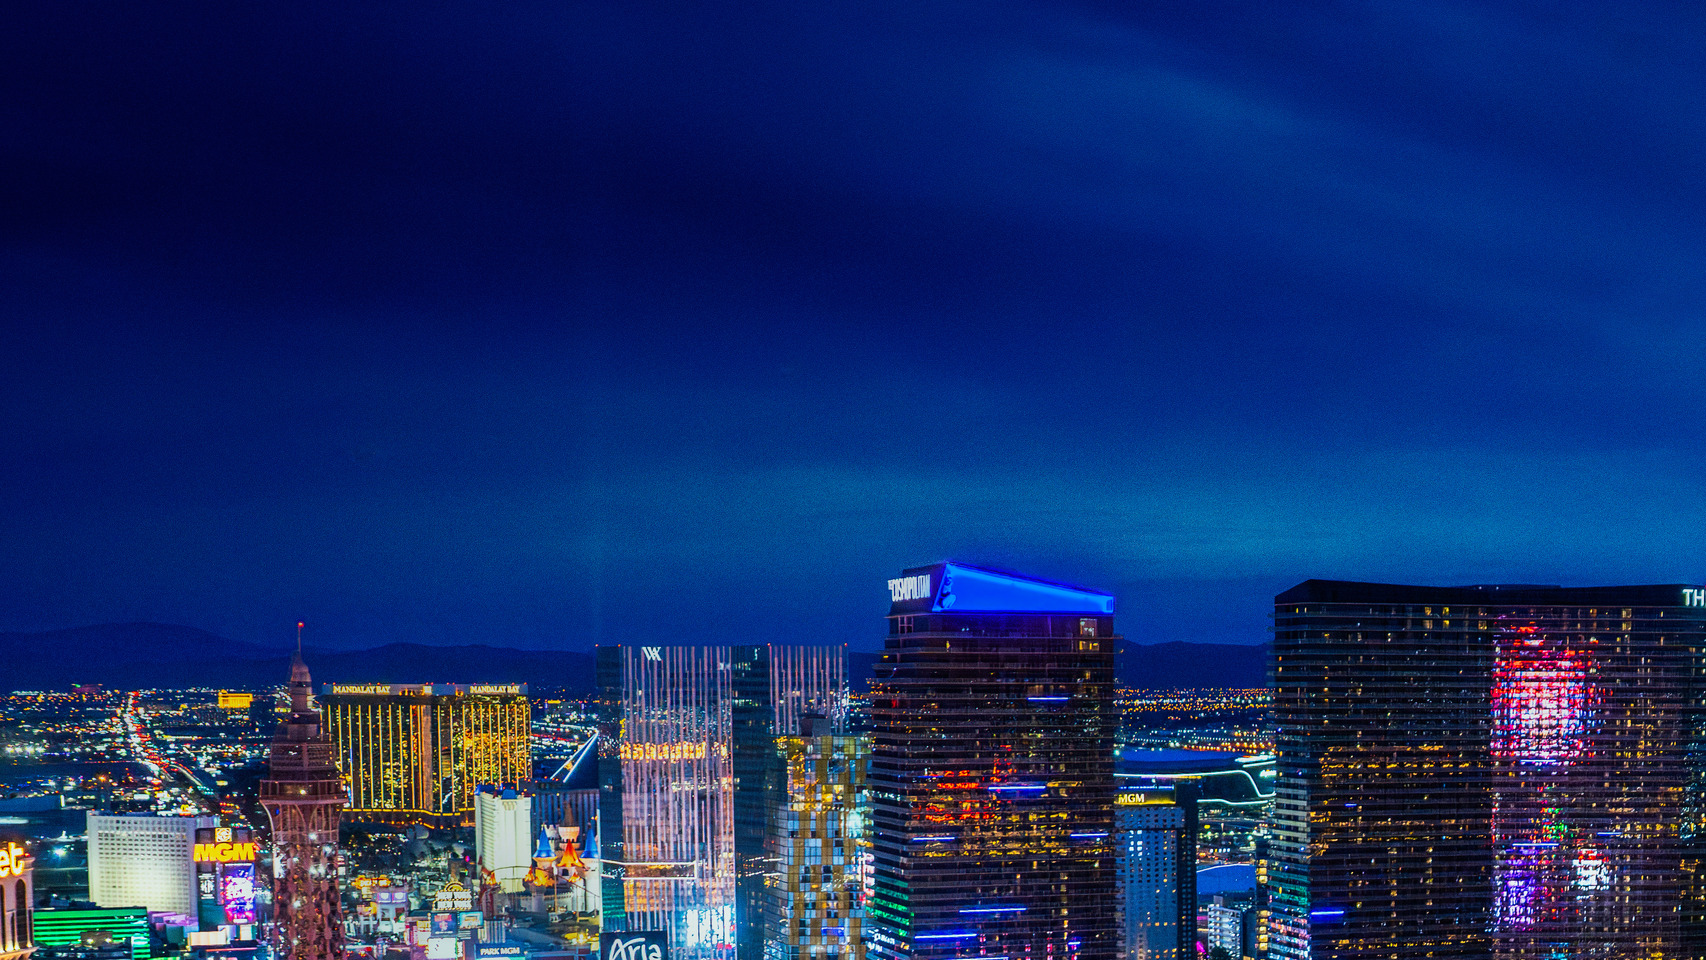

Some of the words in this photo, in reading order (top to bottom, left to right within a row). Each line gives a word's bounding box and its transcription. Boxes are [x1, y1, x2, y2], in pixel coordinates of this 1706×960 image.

[892, 574, 931, 602] COSMOPOLITAN
[333, 685, 375, 694] MANDALAY
[376, 685, 391, 694] BAY
[470, 685, 506, 694] MANDALAY
[507, 685, 520, 694] BAY
[1118, 793, 1145, 803] MGM
[193, 842, 256, 862] MGM
[480, 947, 500, 956] PARK
[500, 947, 520, 955] MGM
